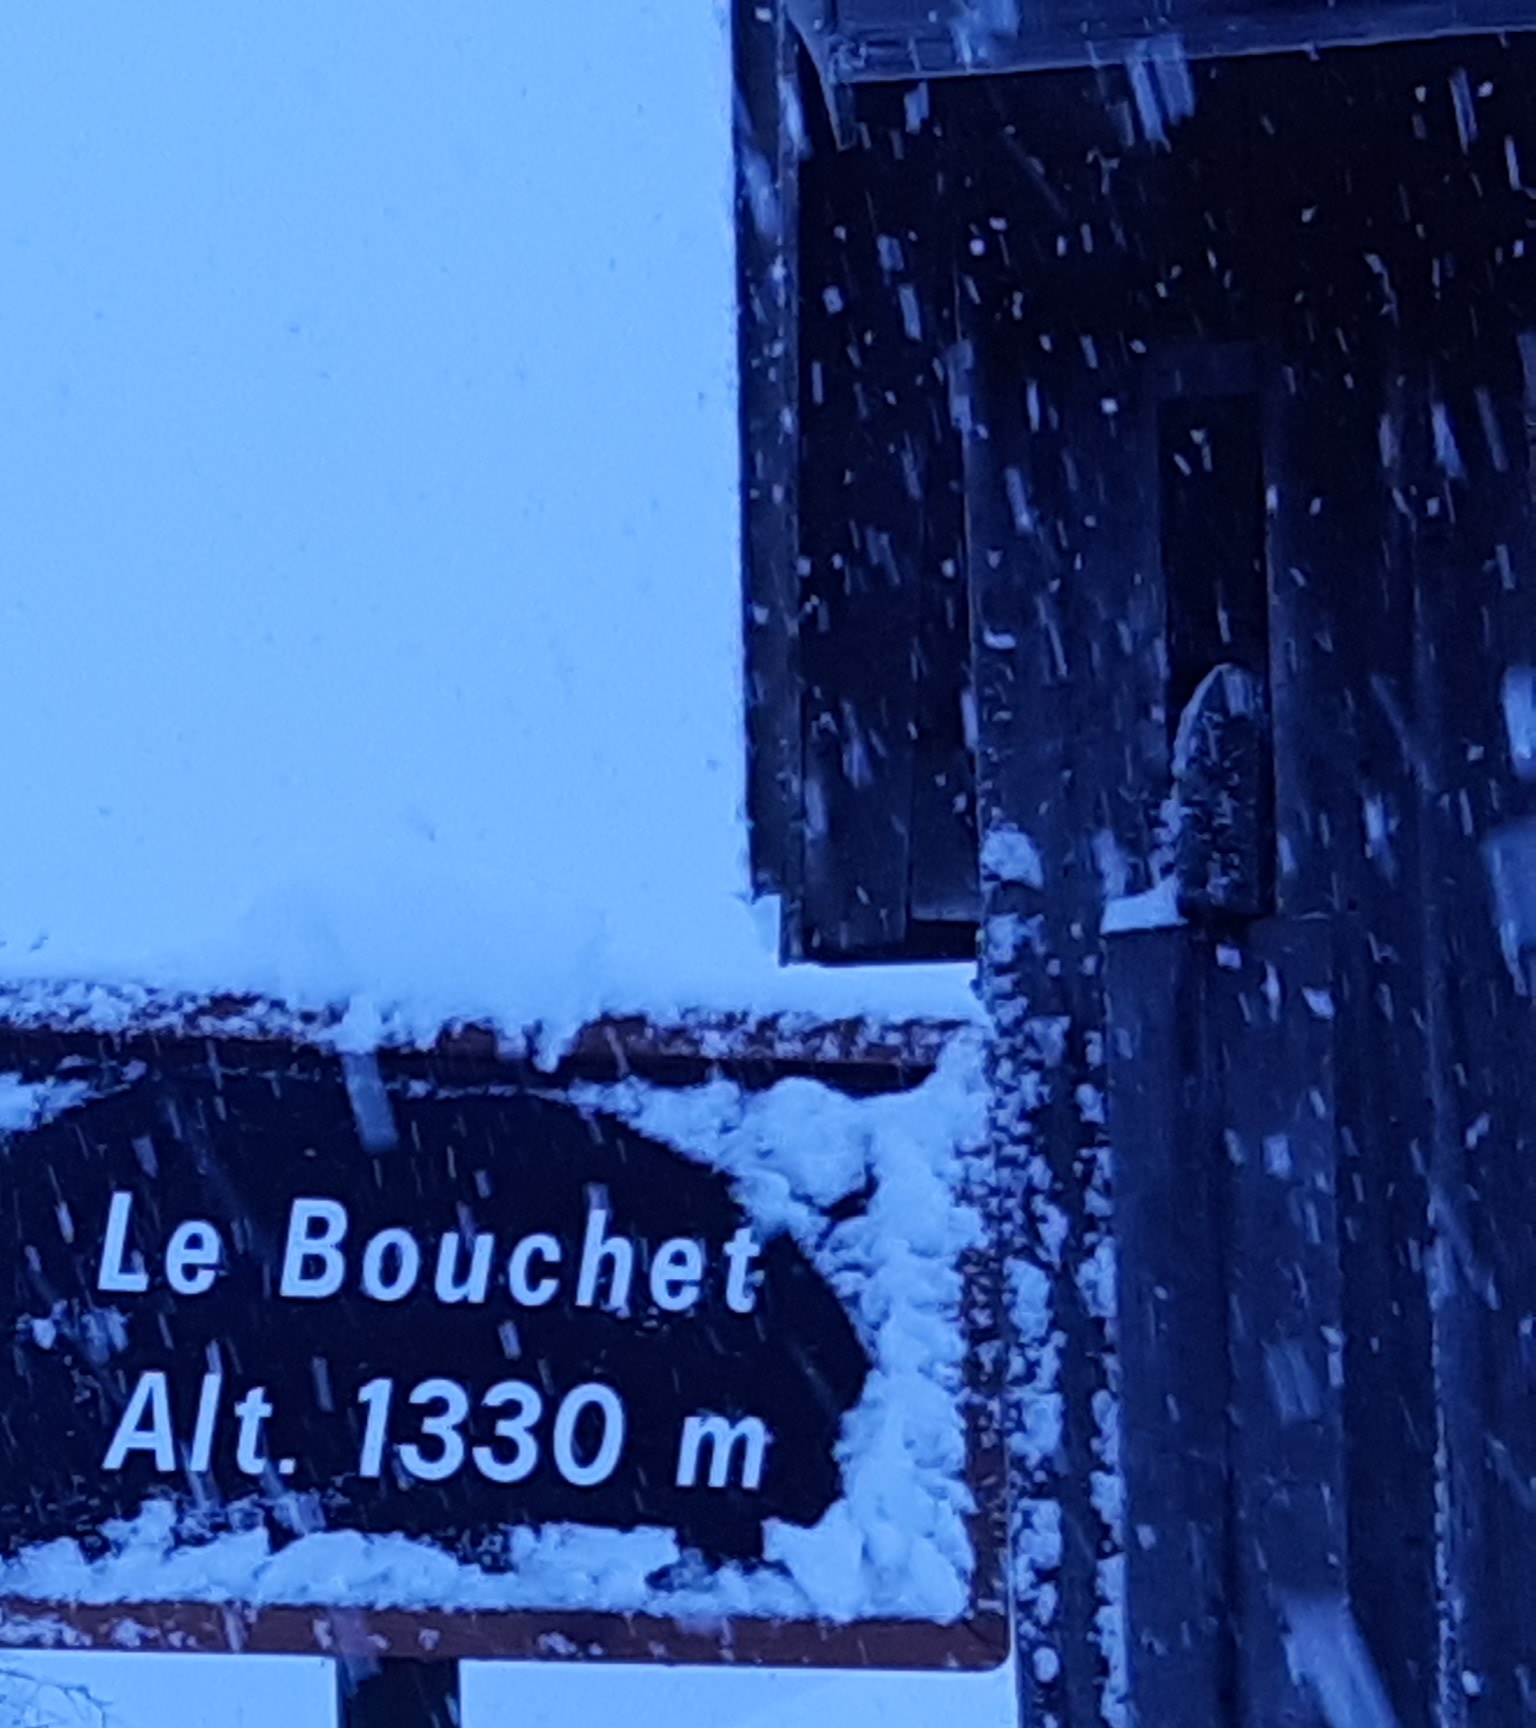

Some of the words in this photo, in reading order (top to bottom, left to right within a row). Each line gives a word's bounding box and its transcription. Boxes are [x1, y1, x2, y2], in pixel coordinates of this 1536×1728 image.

[98, 1191, 222, 1295] Le
[279, 1198, 762, 1315] Bouchet
[101, 1369, 296, 1476] Alt.
[356, 1377, 625, 1487] 1330
[676, 1414, 771, 1489] m
